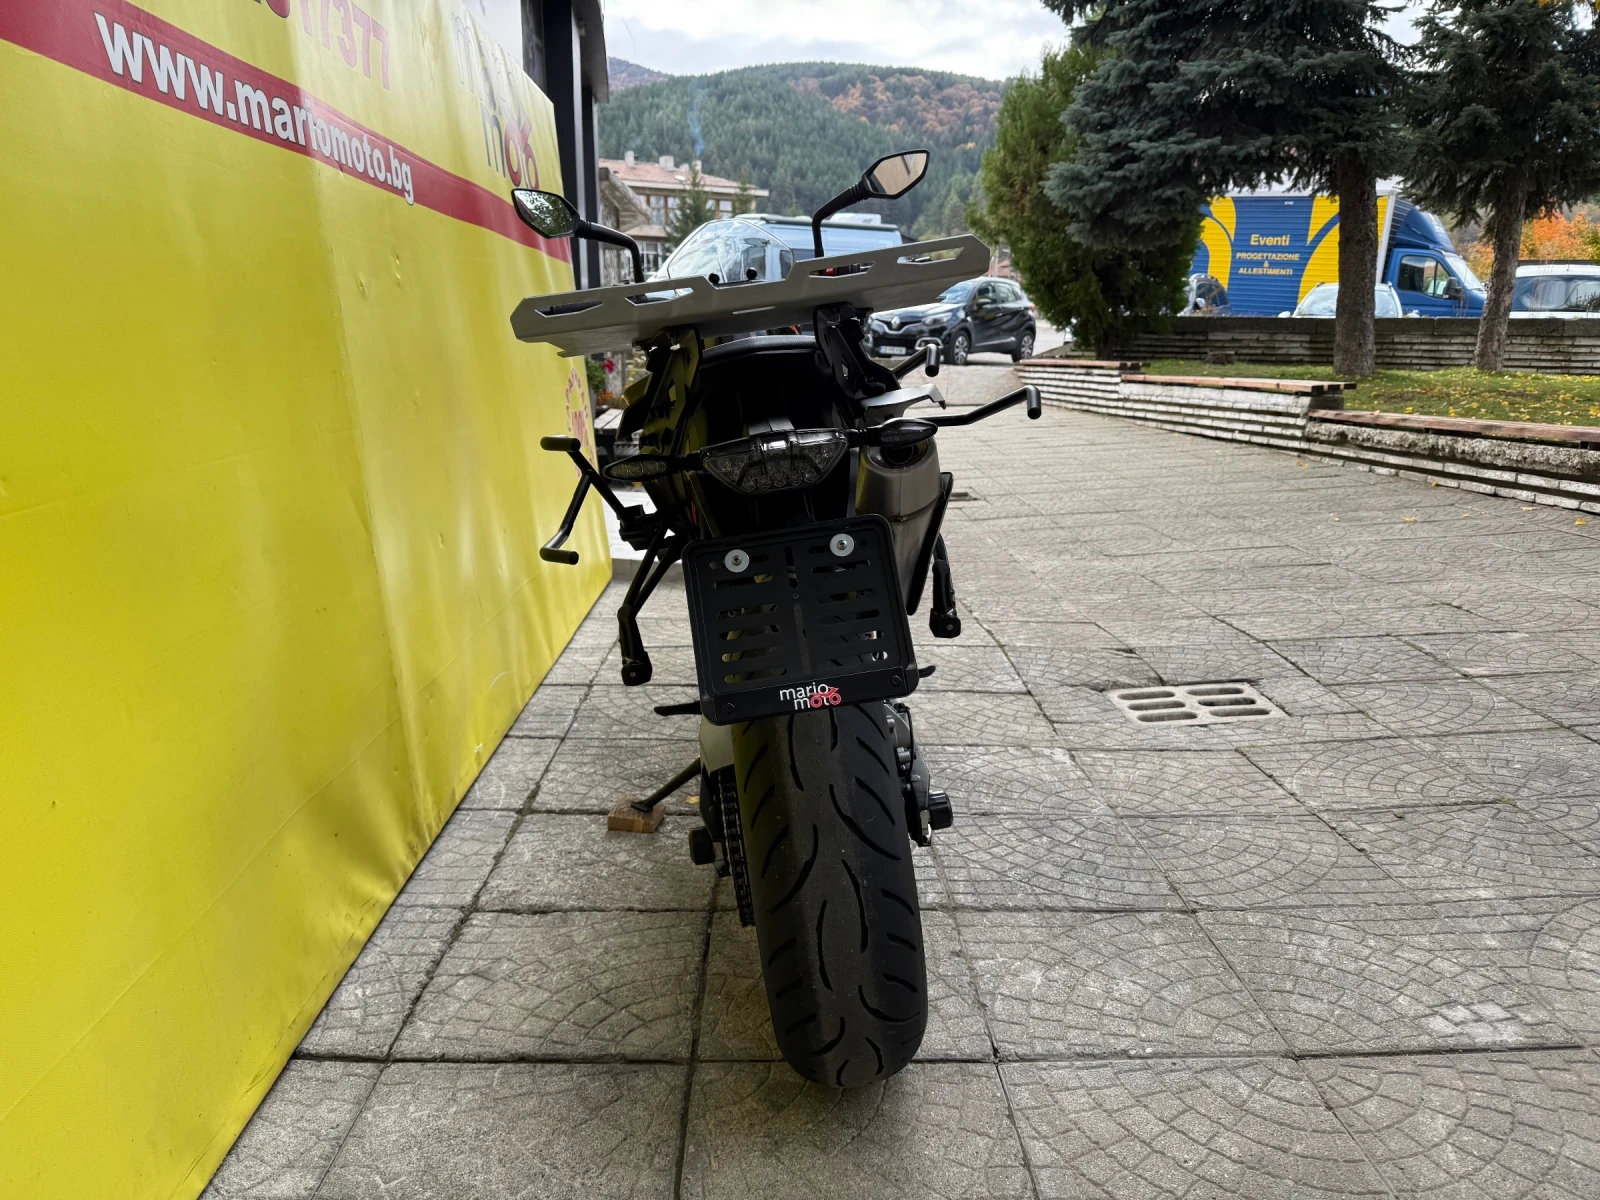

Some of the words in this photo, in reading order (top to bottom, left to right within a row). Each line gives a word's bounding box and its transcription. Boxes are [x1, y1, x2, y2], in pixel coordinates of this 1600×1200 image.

[94, 12, 415, 206] www.mariomoto.bg
[1249, 234, 1291, 246] Eventi
[1235, 252, 1300, 261] PROGETTAZIONE
[1238, 267, 1293, 275] ALLESTIMENTI
[779, 682, 827, 701] mario
[794, 692, 842, 710] moto
